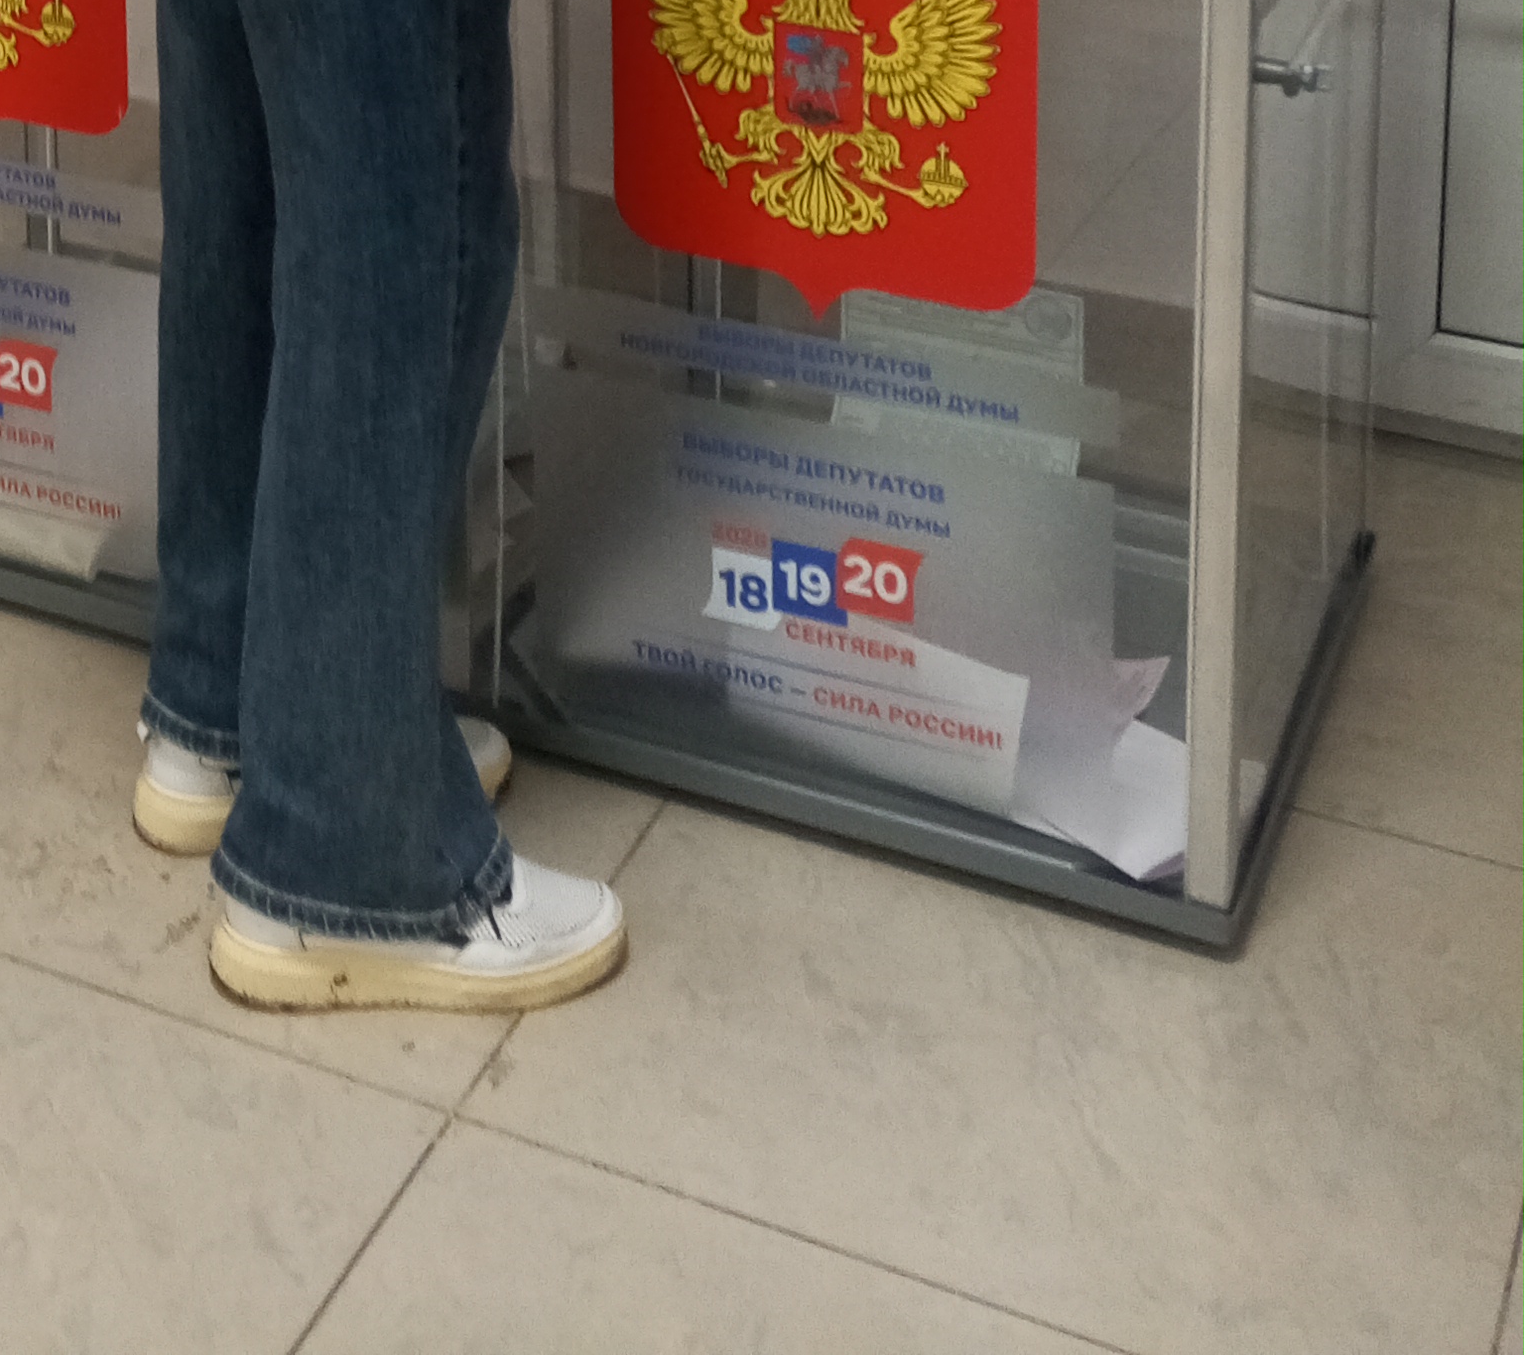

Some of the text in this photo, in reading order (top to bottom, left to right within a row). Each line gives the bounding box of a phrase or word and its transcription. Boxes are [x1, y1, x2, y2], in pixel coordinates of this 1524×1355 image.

[68, 199, 122, 226] ДУМЫ
[799, 344, 932, 382] ДЕПУТАТОВ
[801, 367, 940, 409] ОБЛАСТНОЙ
[946, 395, 1020, 424] ДУМЫ
[683, 432, 945, 505] ВЫБОРЫ ДЕПУТАТОВ
[35, 488, 122, 520] РОССИИ!
[677, 466, 951, 539] ГОСУДАРСТВЕННОЙ ДУМЫ
[718, 554, 908, 613] 18 19 20
[785, 619, 917, 668] СЕНТЯБРЯ
[632, 639, 697, 672] ТВОЙ
[700, 660, 784, 693] ГОЛОС
[813, 686, 881, 719] СИЛА
[888, 704, 1004, 751] РОССИИ!
